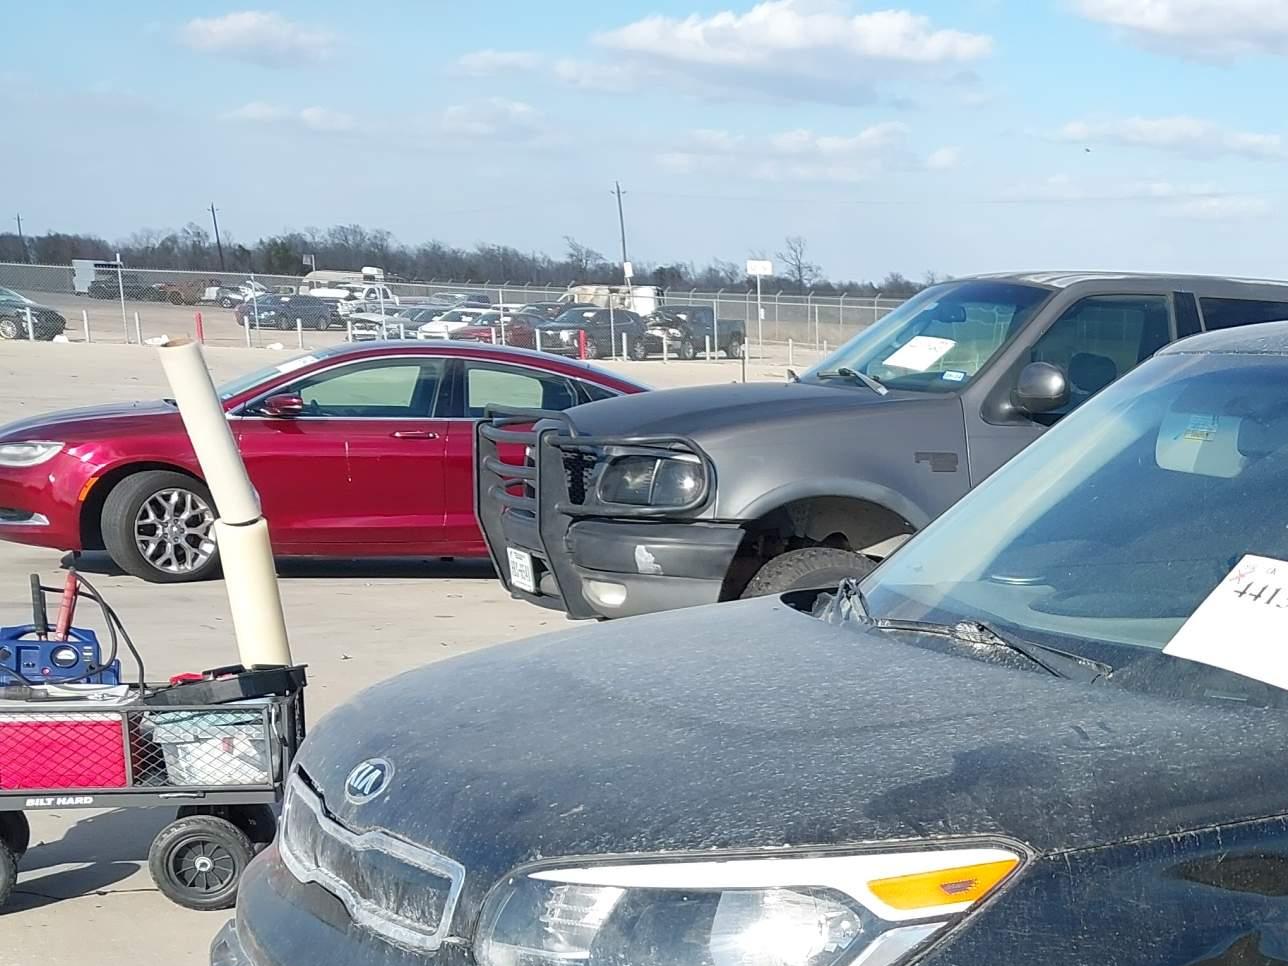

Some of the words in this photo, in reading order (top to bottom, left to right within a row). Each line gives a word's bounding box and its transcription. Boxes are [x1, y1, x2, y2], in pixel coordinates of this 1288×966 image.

[348, 761, 385, 797] KIA
[25, 797, 55, 807] BILT
[56, 796, 94, 806] HARD
